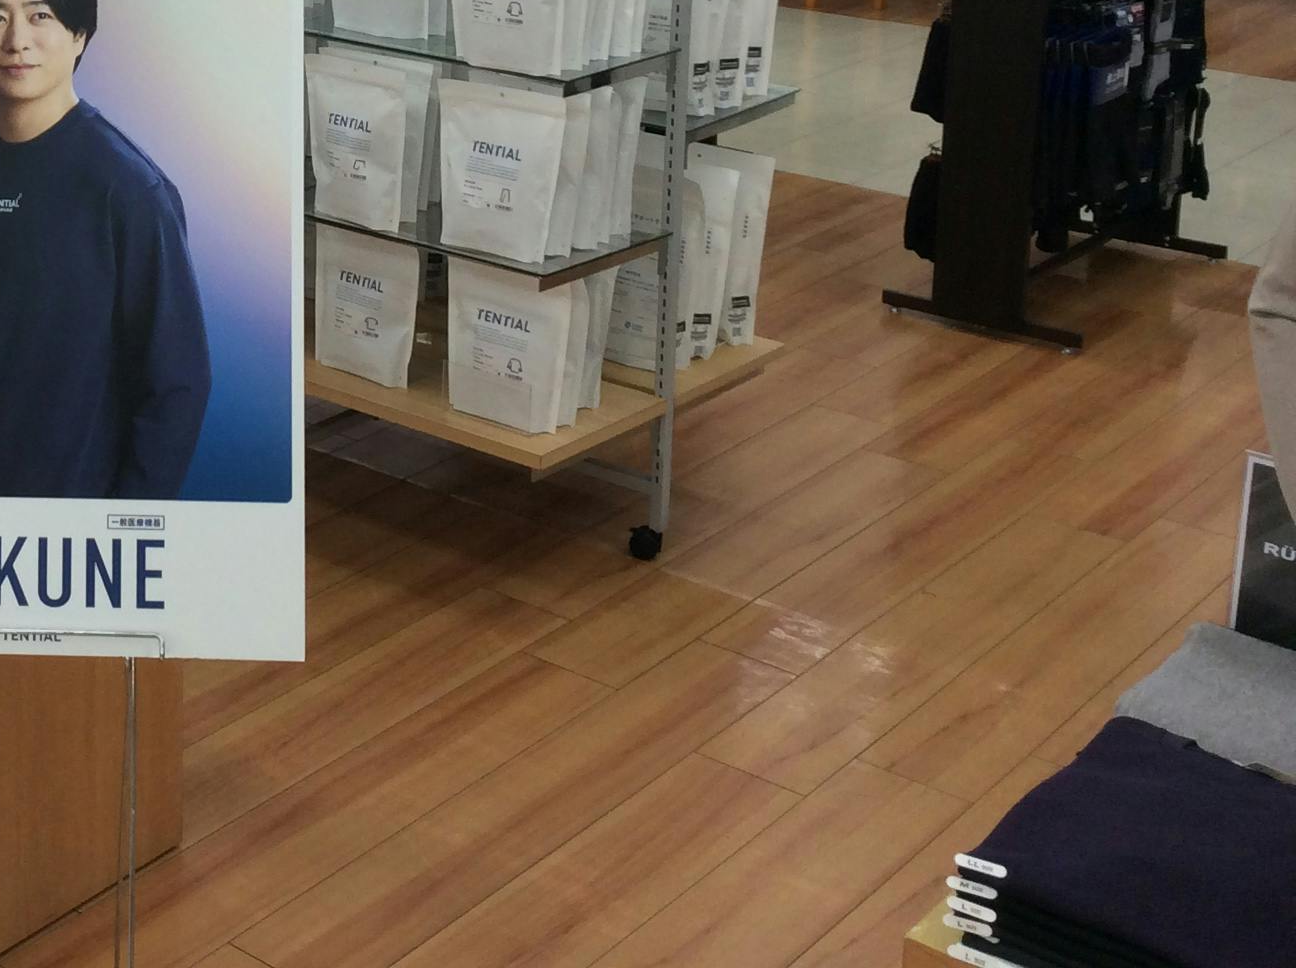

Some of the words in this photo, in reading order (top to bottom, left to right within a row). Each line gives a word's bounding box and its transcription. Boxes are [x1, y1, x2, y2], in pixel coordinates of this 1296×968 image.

[328, 112, 372, 133] TENTIAL
[472, 139, 522, 162] TENTIAL
[339, 269, 384, 294] TENTIAL
[476, 308, 531, 334] TENTIAL
[3, 631, 62, 643] TENTIAL
